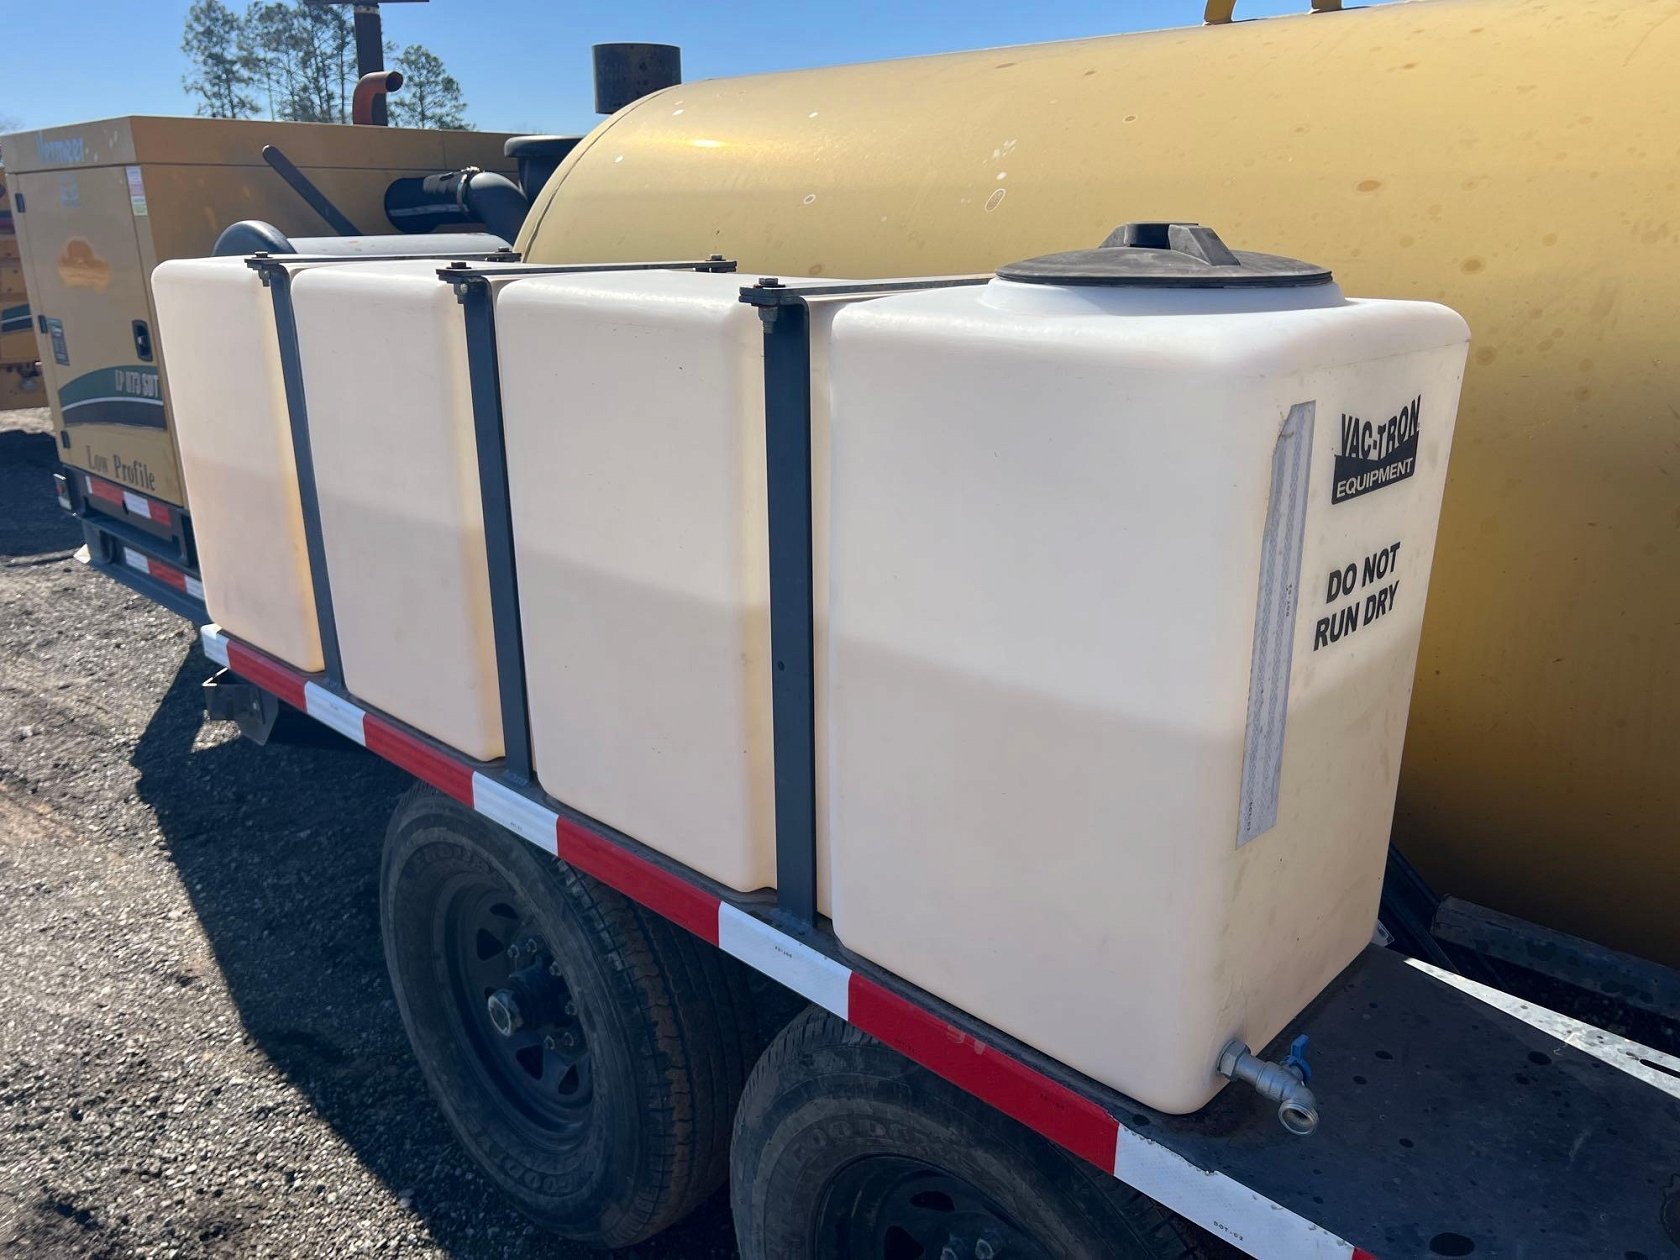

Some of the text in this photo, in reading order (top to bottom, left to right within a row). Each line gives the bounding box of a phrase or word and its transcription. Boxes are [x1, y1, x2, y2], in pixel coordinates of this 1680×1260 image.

[86, 445, 156, 491] Low Profile
[1336, 457, 1414, 499] EQUIPMENT
[1326, 562, 1357, 604] DO
[1361, 541, 1400, 588] NOT
[1313, 580, 1400, 652] RUN DRY
